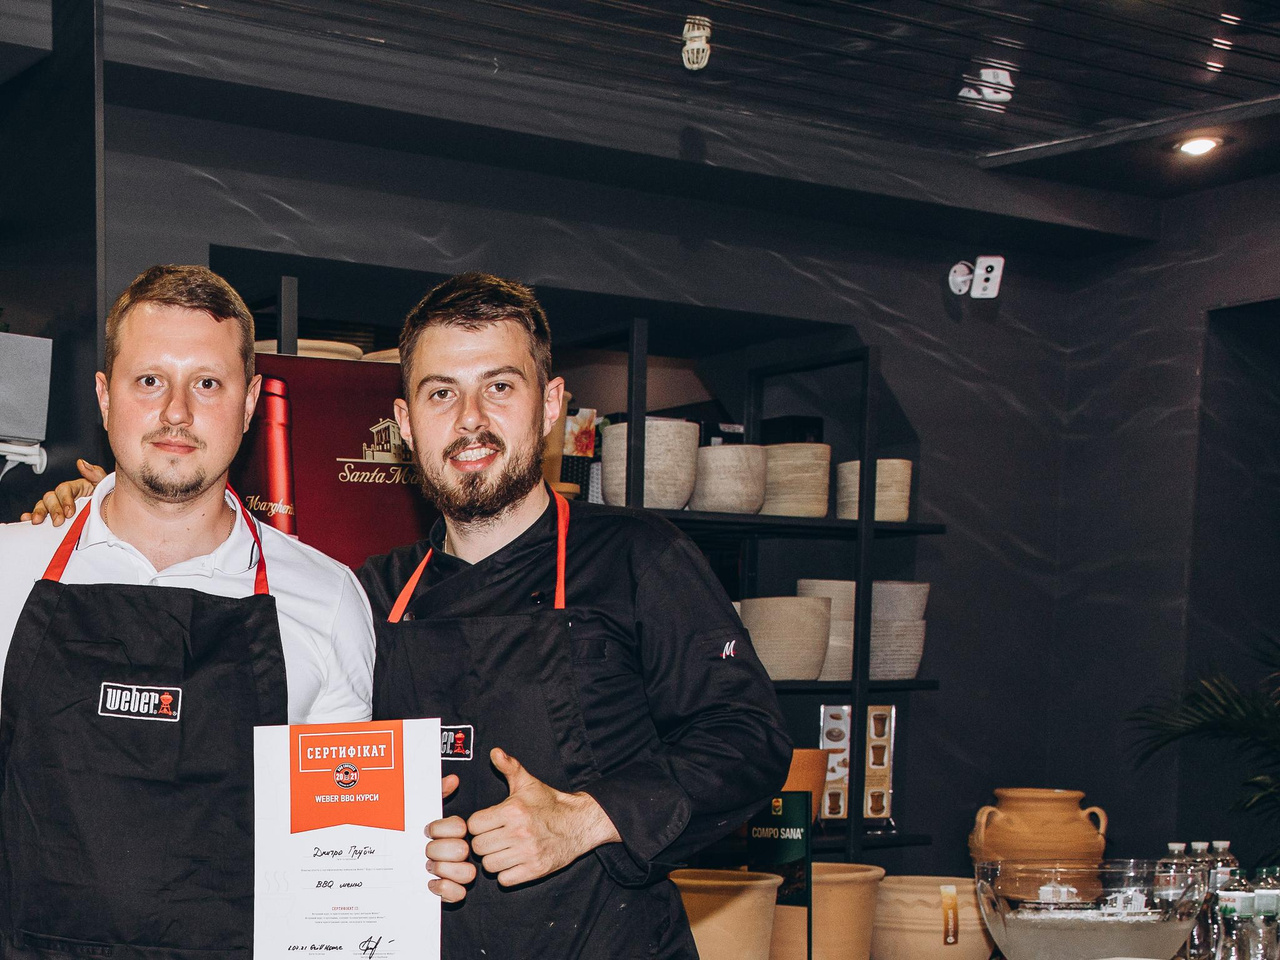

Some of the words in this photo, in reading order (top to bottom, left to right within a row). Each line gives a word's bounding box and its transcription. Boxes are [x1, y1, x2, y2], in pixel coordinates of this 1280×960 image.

[338, 463, 386, 483] Santa
[245, 495, 295, 517] Margheri
[106, 687, 160, 714] weber
[307, 744, 387, 760] СЕРТИФІКАТ
[315, 795, 340, 803] WEBER
[340, 794, 355, 802] BBQ
[356, 793, 380, 802] КУРСИ
[751, 827, 780, 839] COMPO
[315, 880, 335, 890] BBQ
